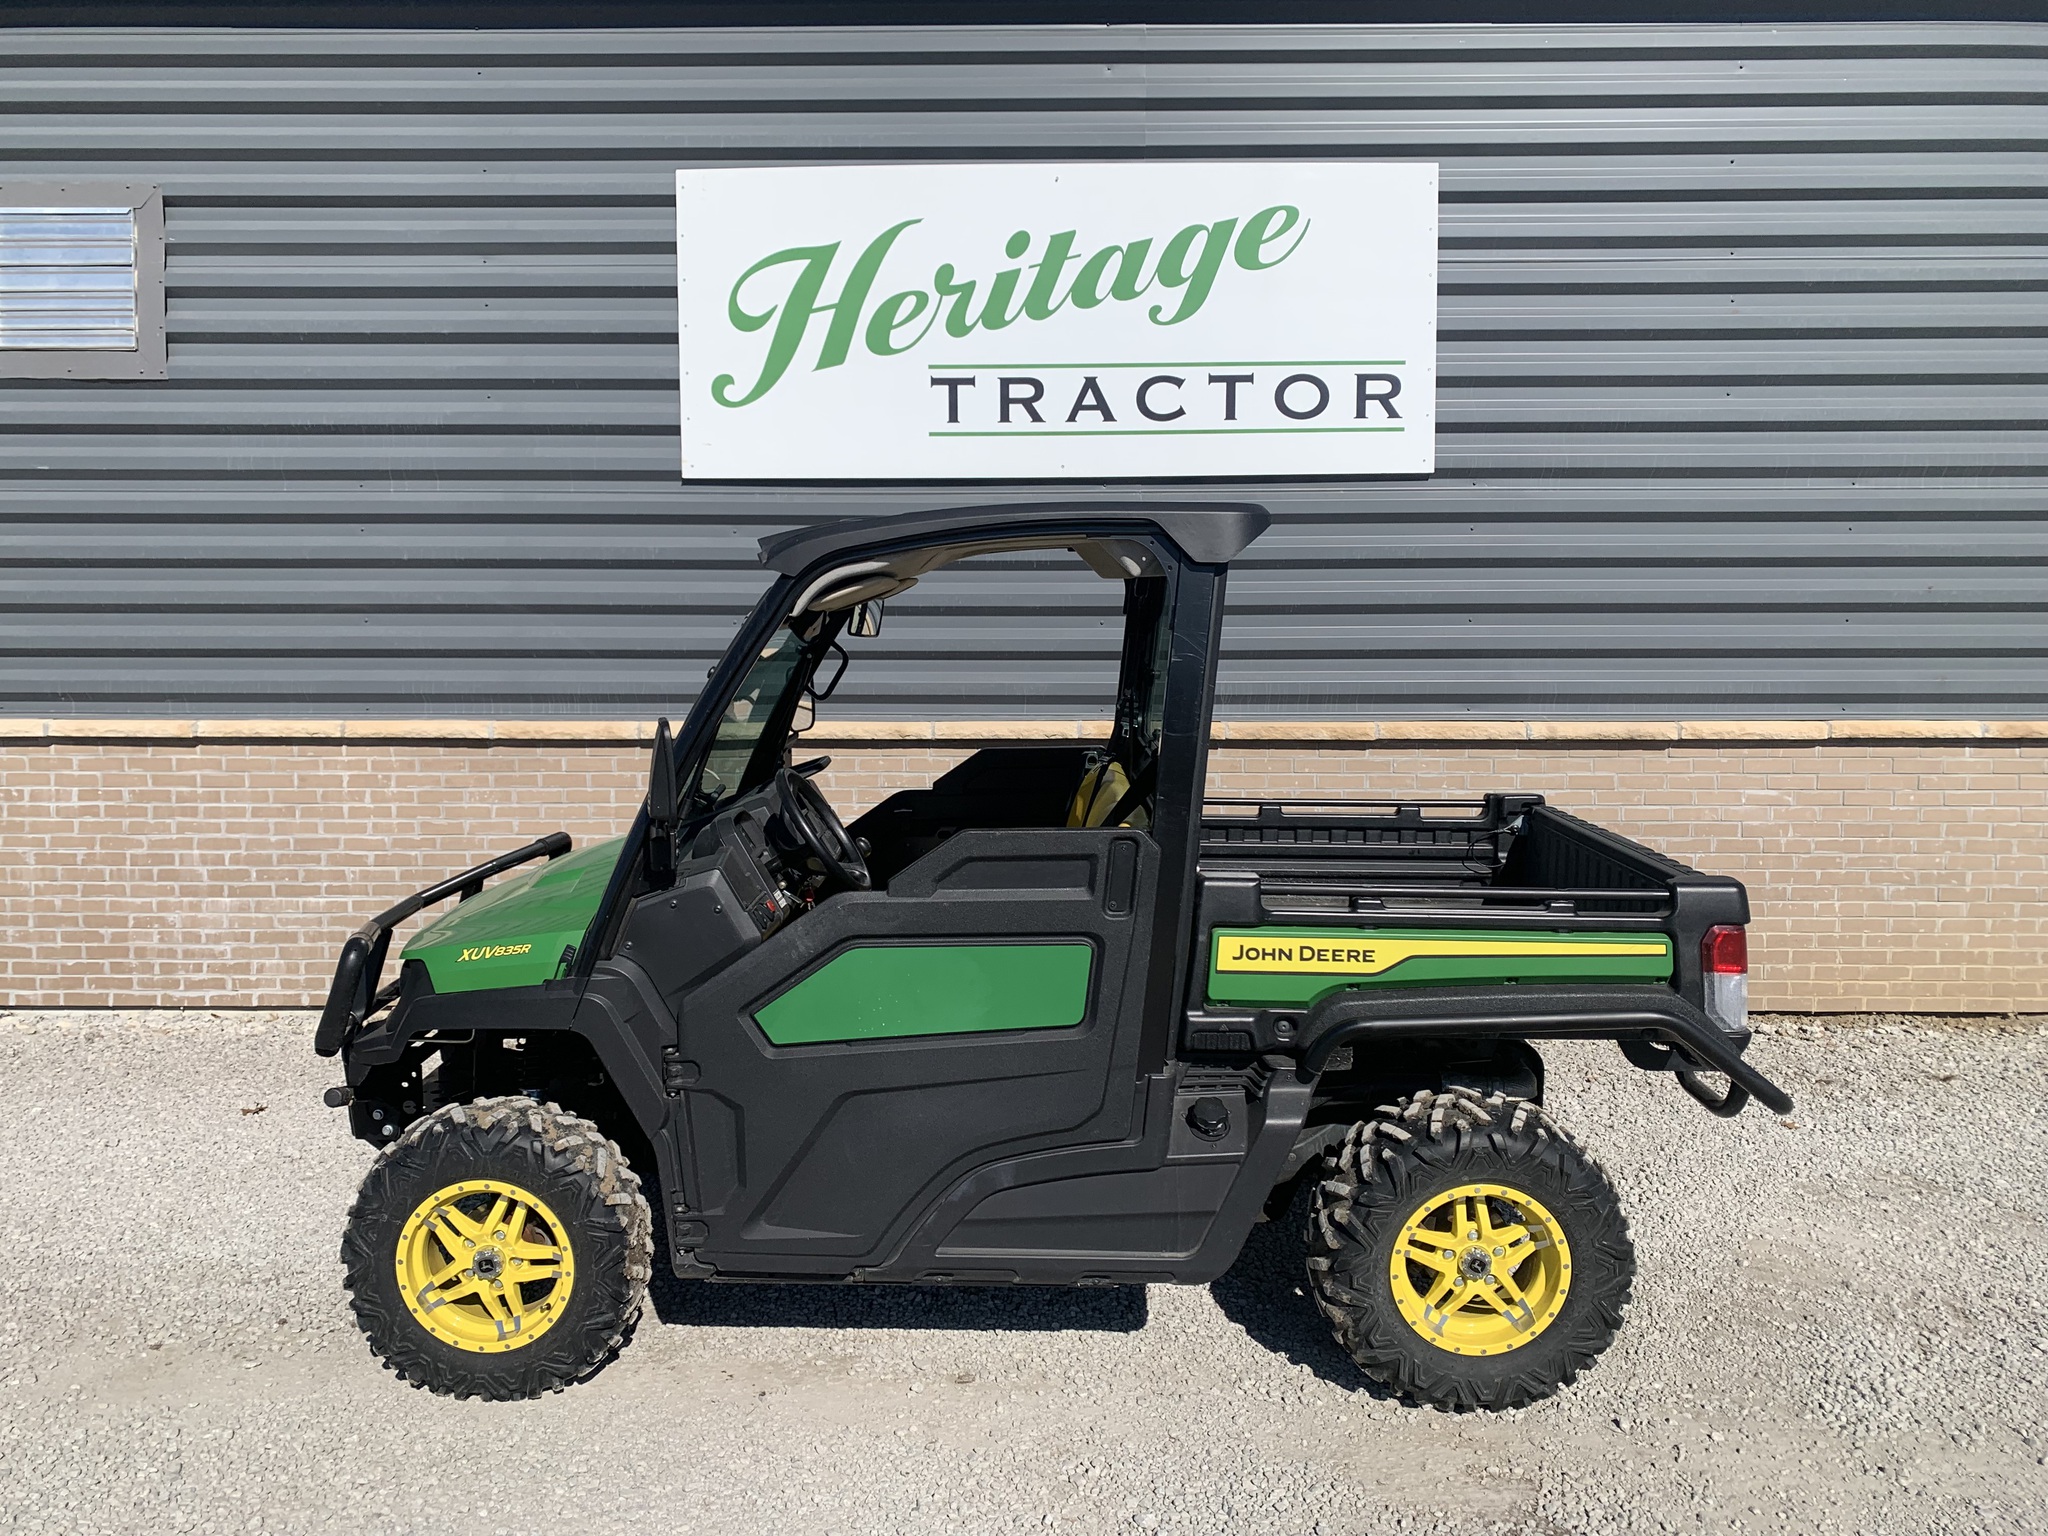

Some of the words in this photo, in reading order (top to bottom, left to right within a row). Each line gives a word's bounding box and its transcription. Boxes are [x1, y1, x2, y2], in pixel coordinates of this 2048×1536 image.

[711, 204, 1310, 408] Heritage
[930, 373, 1402, 424] TRACTOR
[455, 943, 532, 962] XUV835R
[1232, 944, 1293, 961] JOHN
[1299, 945, 1375, 963] DEERE
